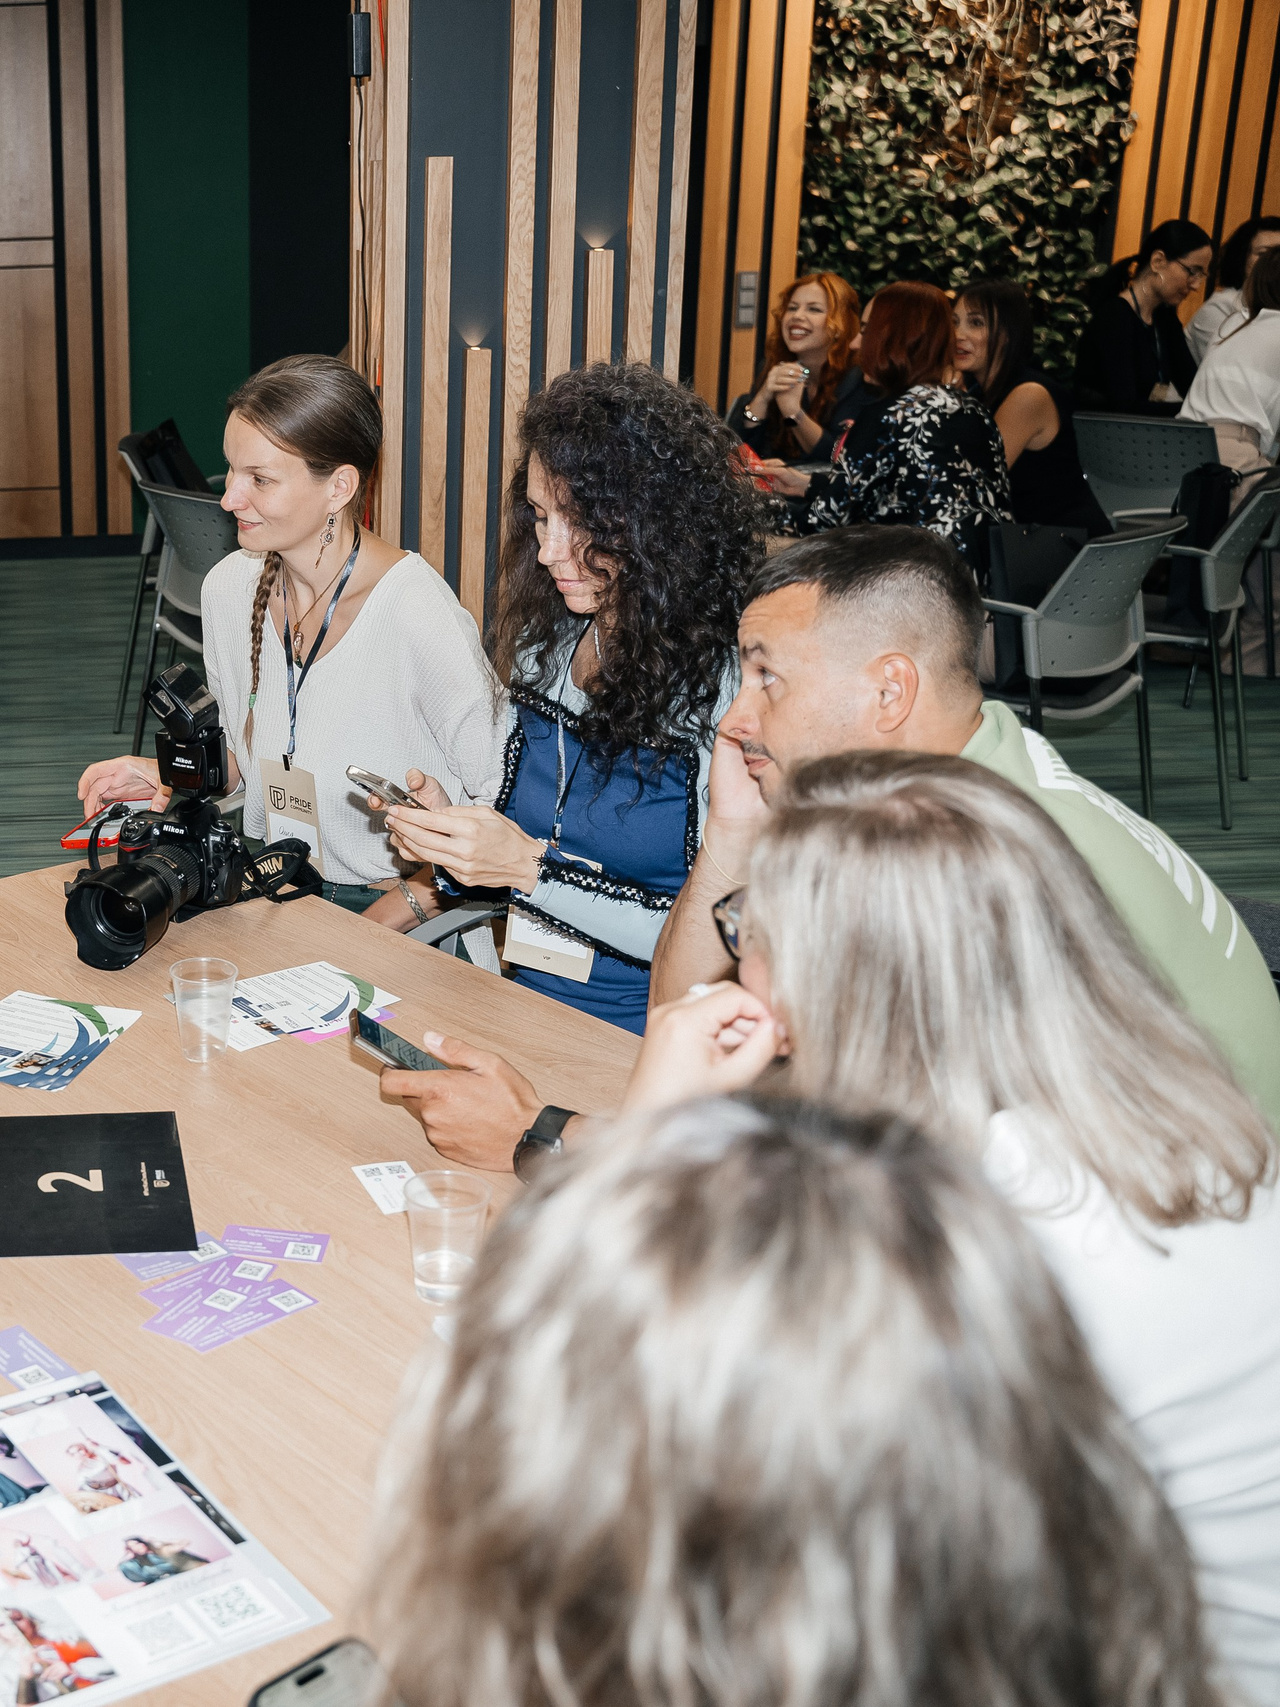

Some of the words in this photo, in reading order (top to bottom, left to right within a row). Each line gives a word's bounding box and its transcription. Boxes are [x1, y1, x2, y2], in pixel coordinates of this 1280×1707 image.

[175, 756, 192, 765] Nikon
[289, 795, 312, 811] PRIDE
[289, 805, 313, 815] COMMUNITY
[162, 824, 185, 835] Nikon
[37, 1168, 104, 1194] 2
